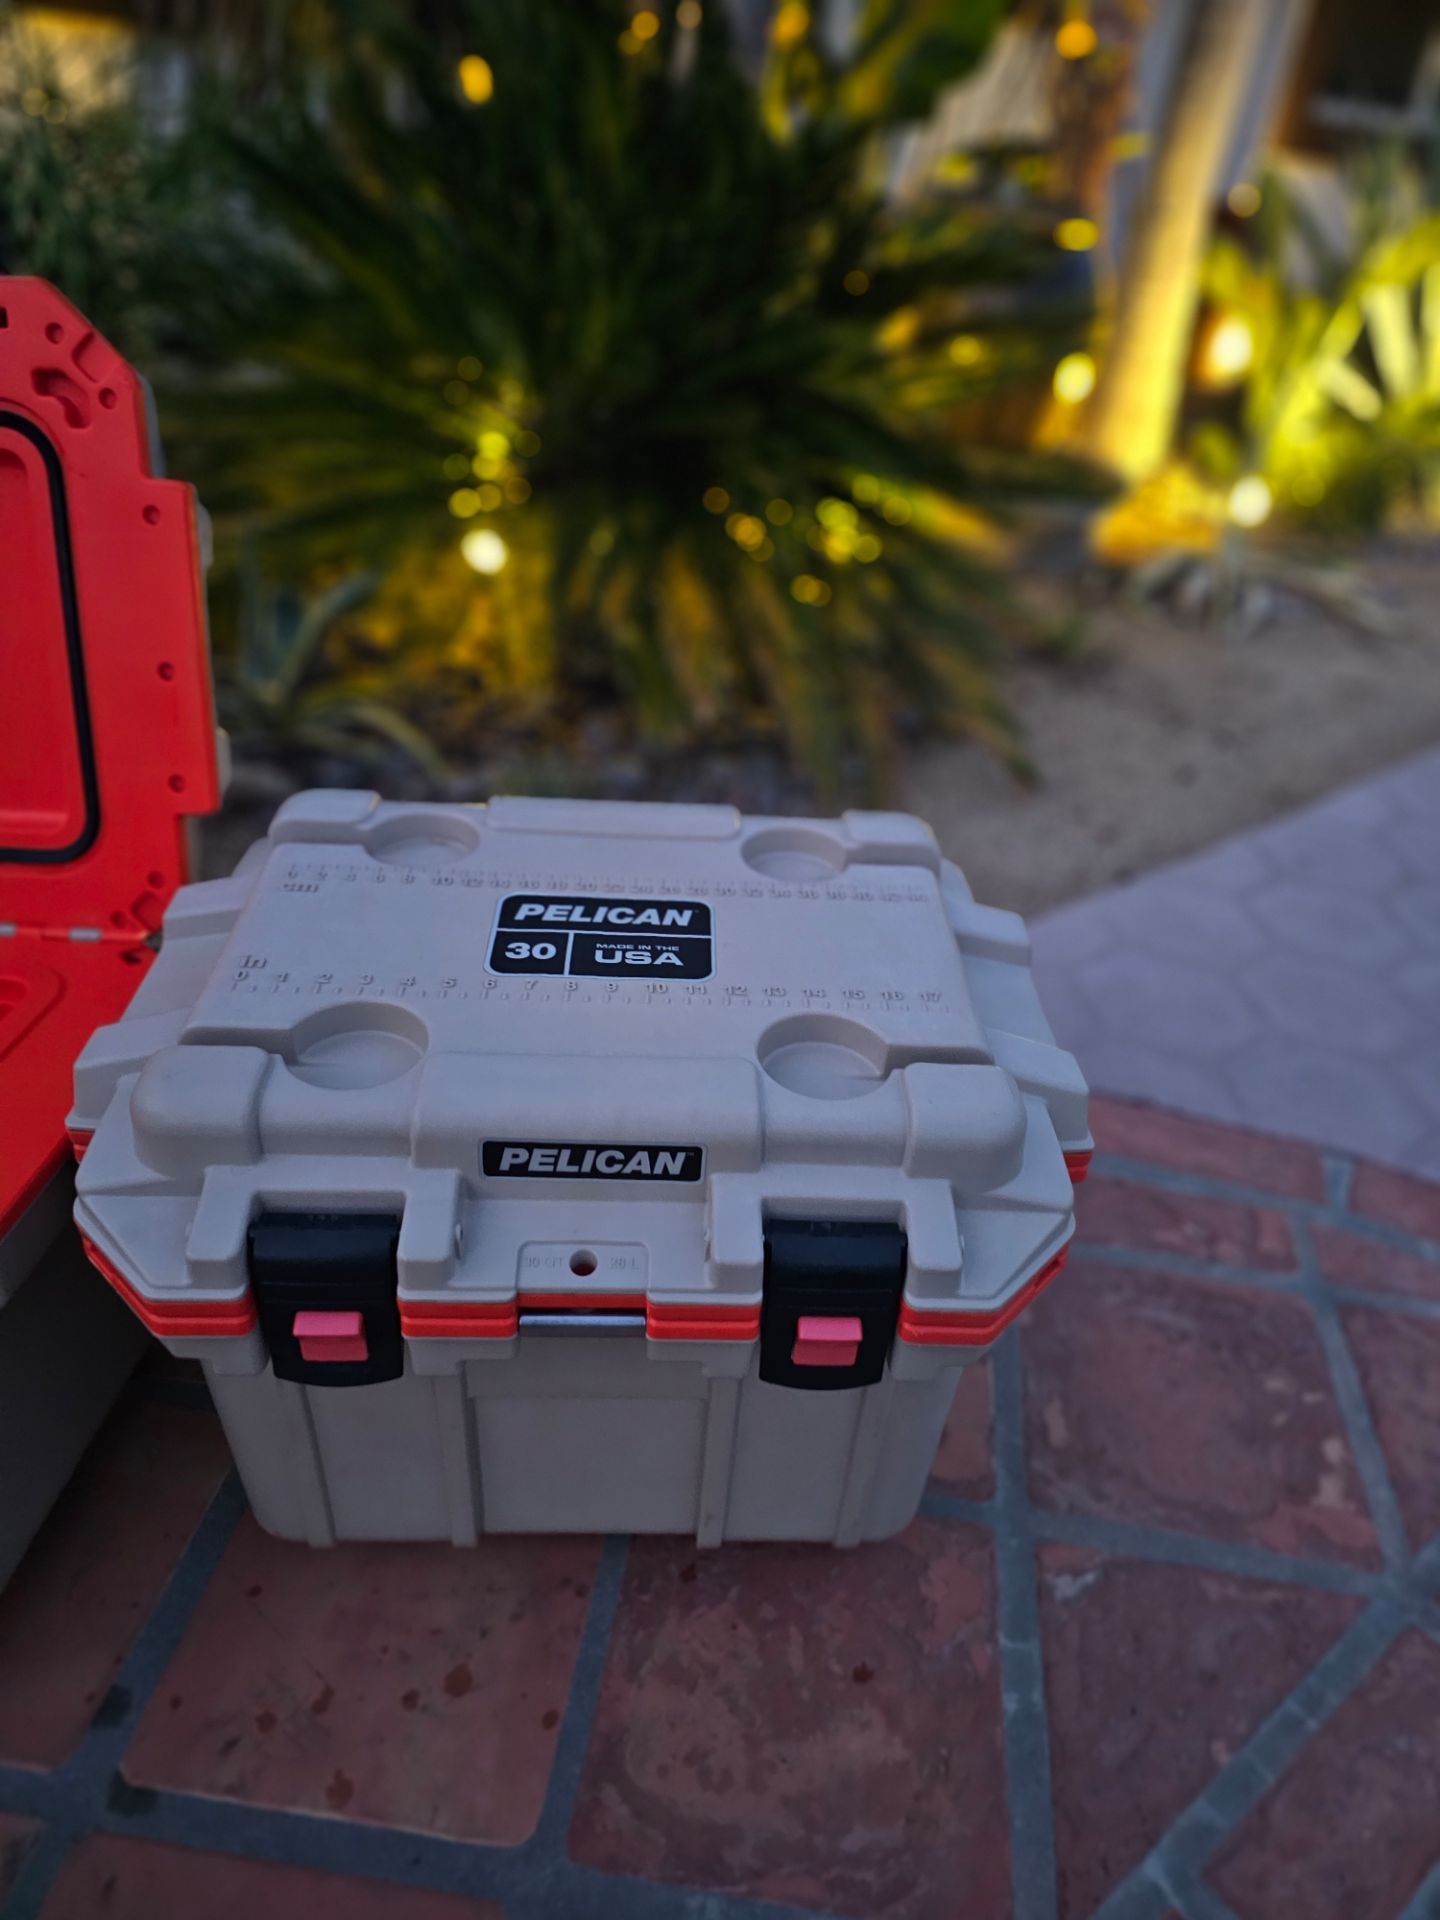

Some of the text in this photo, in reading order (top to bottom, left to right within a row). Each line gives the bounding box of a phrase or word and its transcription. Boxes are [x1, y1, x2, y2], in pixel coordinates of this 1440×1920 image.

[514, 902, 693, 927] PELICAN
[504, 941, 557, 960] 30
[594, 949, 684, 967] USA
[654, 944, 680, 952] THE
[318, 972, 334, 985] 2
[361, 973, 375, 986] 3
[402, 976, 416, 988] 4
[443, 977, 458, 989] 5
[484, 979, 497, 990] 6
[525, 979, 539, 991] 7
[566, 980, 578, 992] 8
[607, 981, 619, 993] 9
[647, 983, 668, 994] 10
[686, 984, 707, 995] 11
[724, 985, 748, 997] 12
[763, 986, 787, 997] 13
[803, 987, 826, 998] 14
[842, 988, 866, 1000] 15
[880, 989, 904, 1001] 16
[499, 1147, 687, 1176] PELICAN
